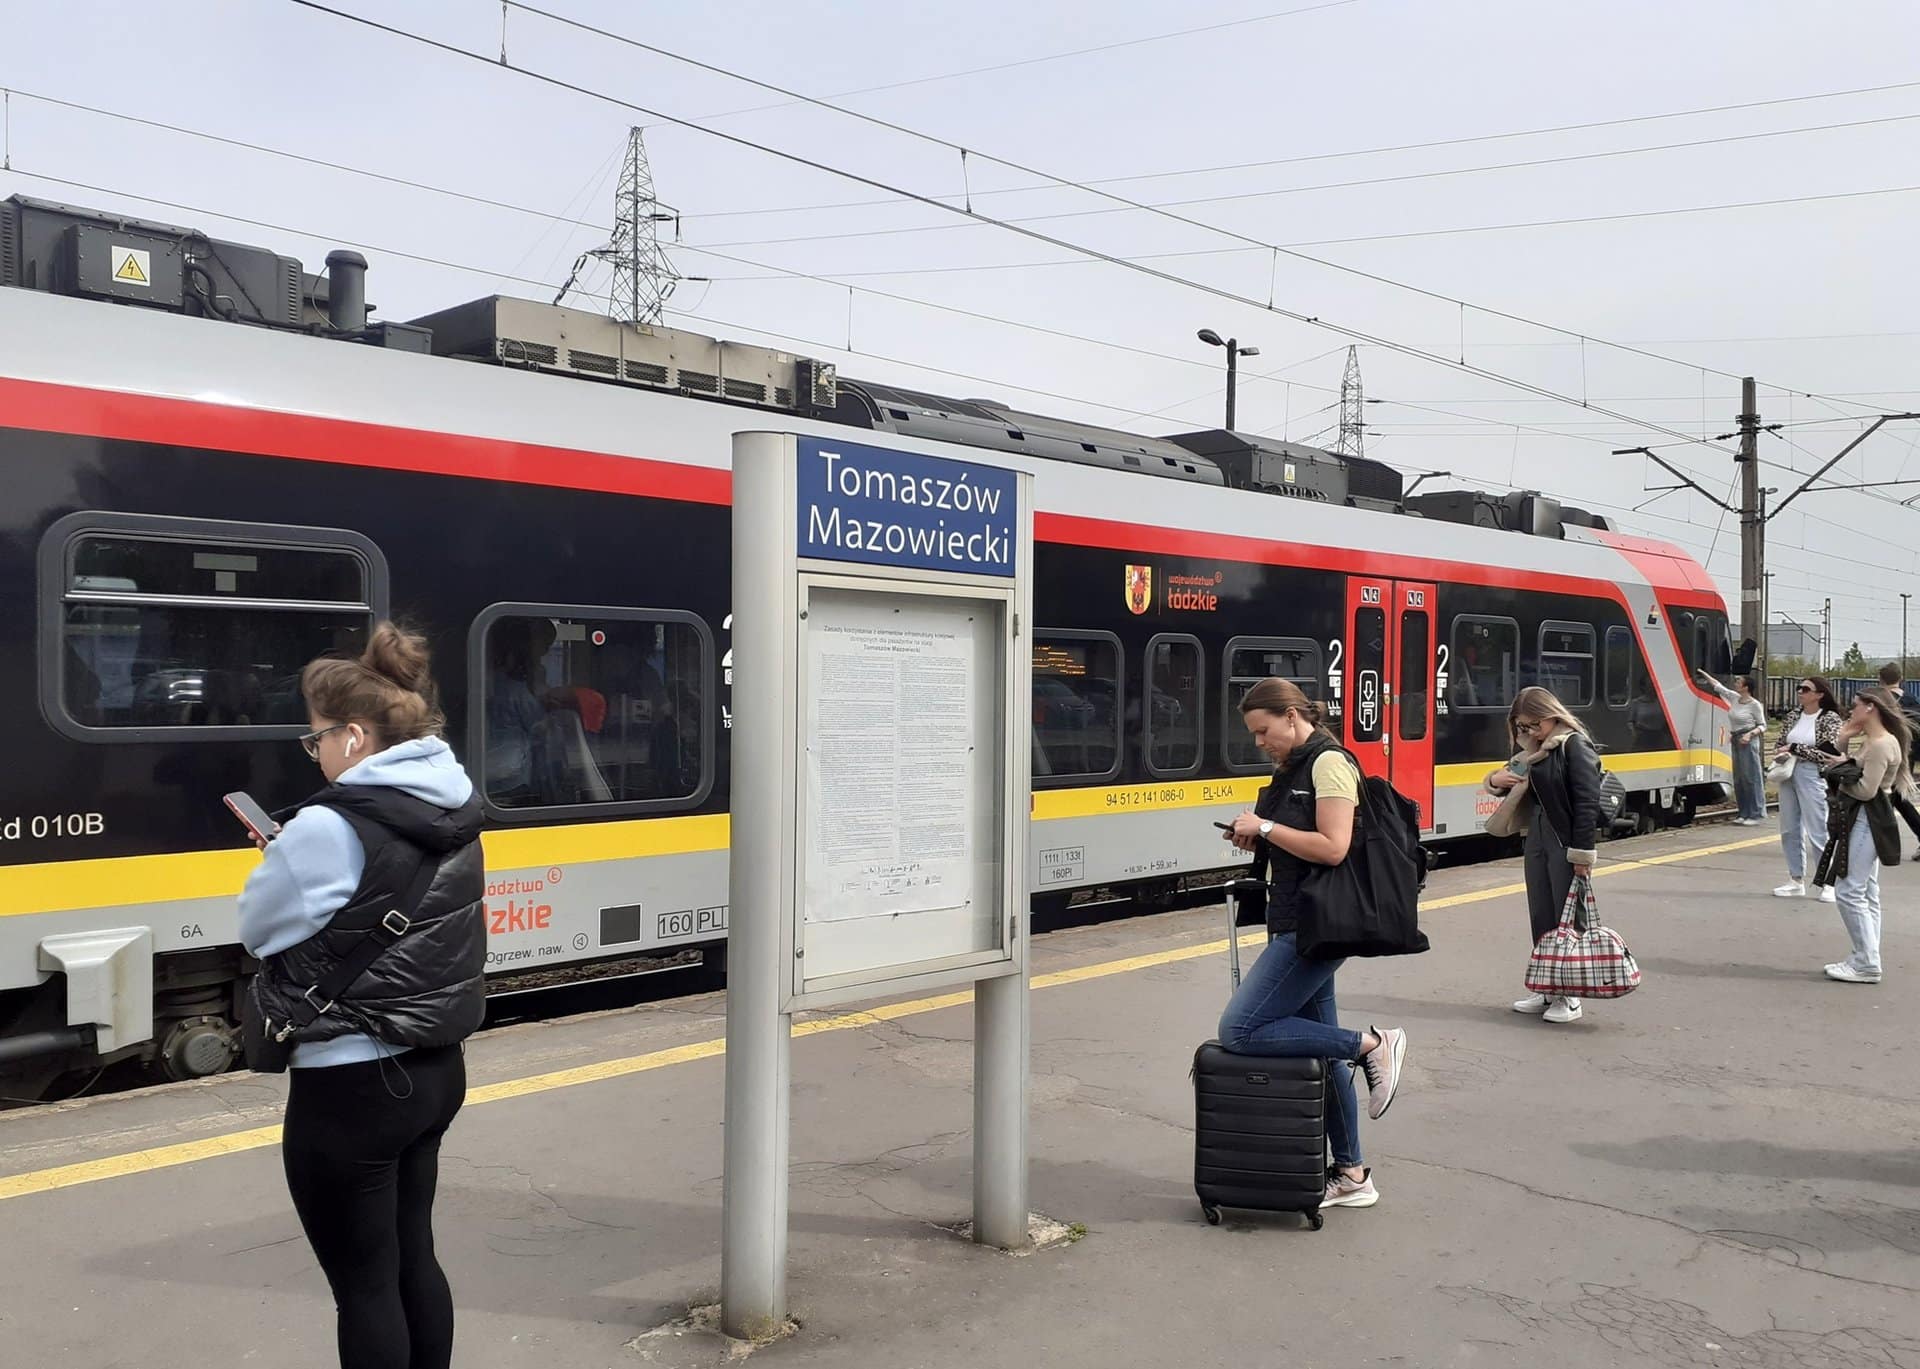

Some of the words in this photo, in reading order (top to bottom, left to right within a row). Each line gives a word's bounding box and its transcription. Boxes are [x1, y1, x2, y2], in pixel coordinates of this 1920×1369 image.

[819, 450, 1000, 514] Tomaszów
[808, 504, 1009, 564] Mazowiecki
[1168, 587, 1217, 611] łódzkie
[1328, 639, 1342, 675] 2
[1437, 644, 1449, 677] 2
[1106, 793, 1117, 806] 94
[1120, 792, 1131, 805] 51
[1134, 791, 1140, 804] 2
[1143, 790, 1157, 803] 141
[1160, 788, 1184, 801] 086-0
[1203, 785, 1233, 799] PL-LKA
[0, 816, 20, 839] d
[31, 813, 104, 838] 010B
[483, 879, 544, 897] ództwo
[181, 924, 203, 938] 6A
[660, 914, 691, 935] 160
[699, 911, 721, 929] PL
[487, 949, 535, 965] Ogrzew.
[538, 945, 564, 957] naw.
